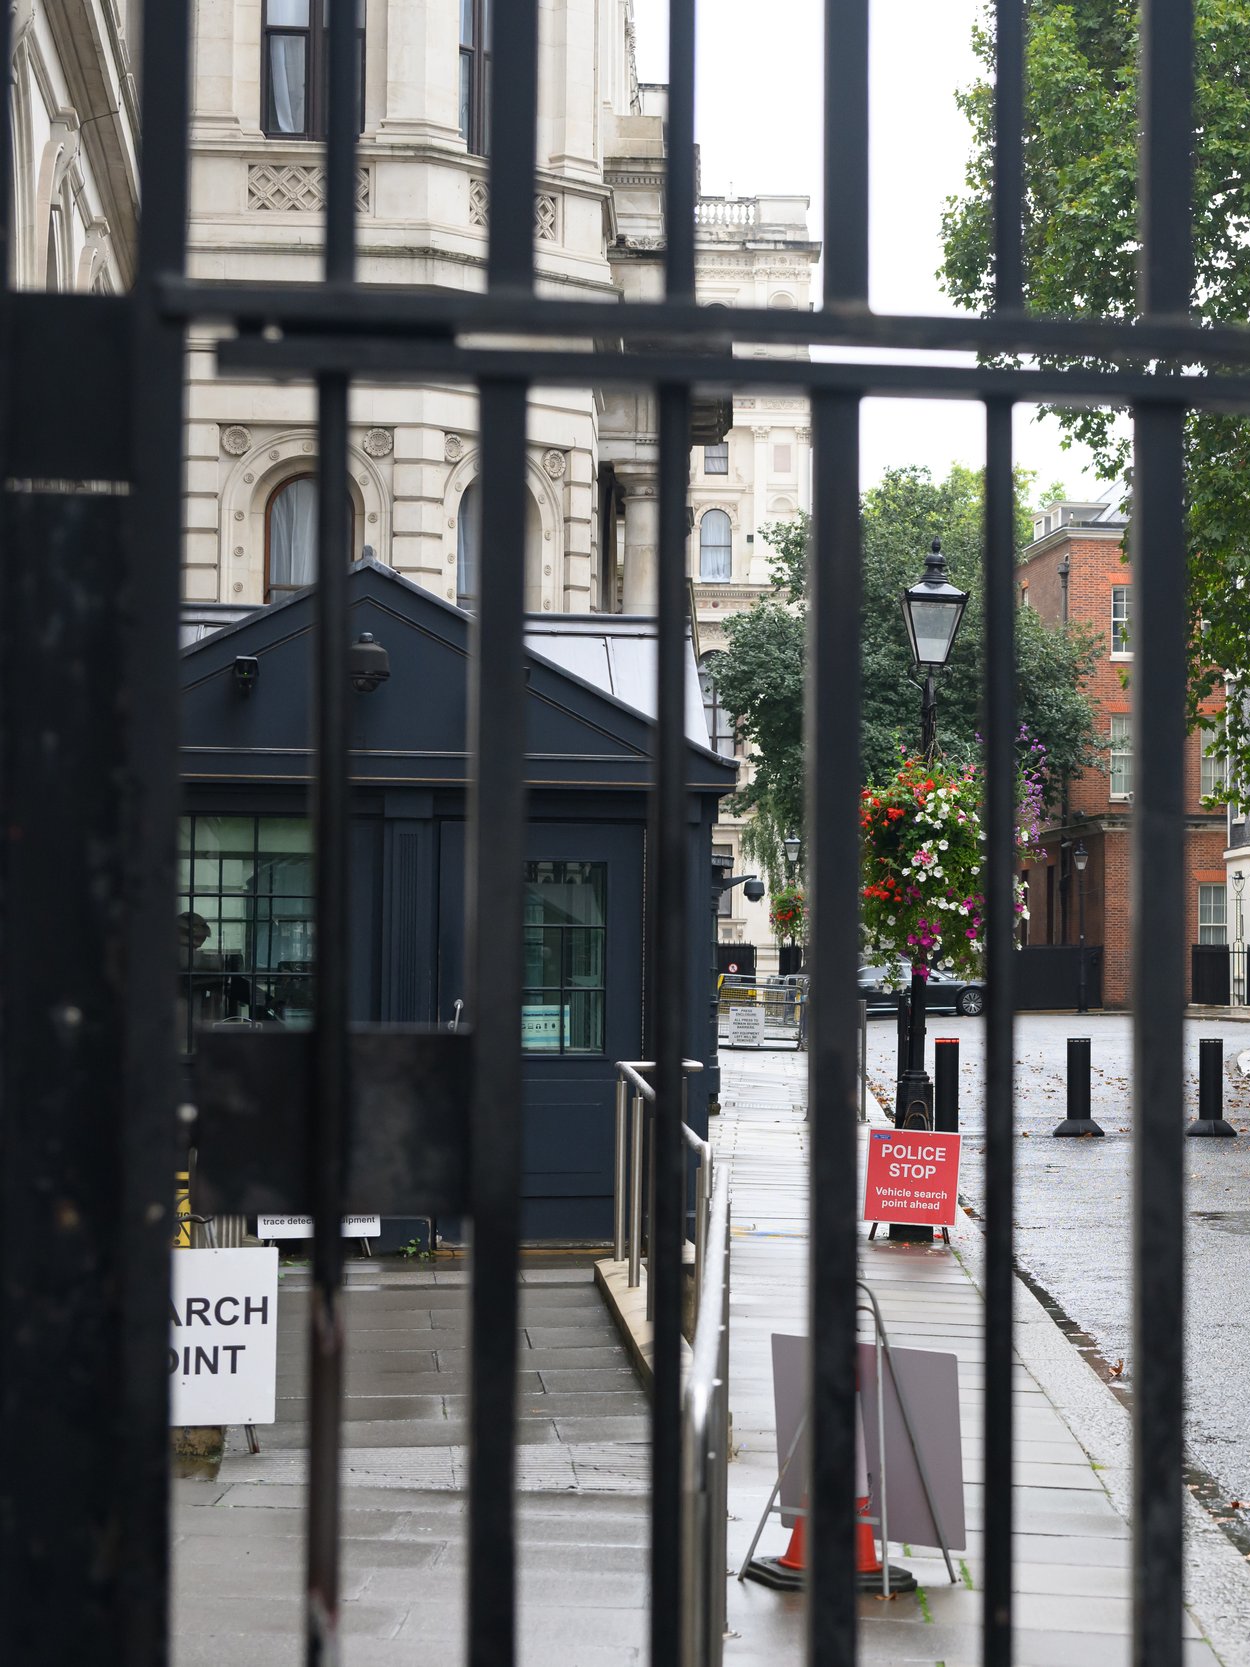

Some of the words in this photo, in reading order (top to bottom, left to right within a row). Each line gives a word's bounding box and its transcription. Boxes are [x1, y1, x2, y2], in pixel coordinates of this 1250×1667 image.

[881, 1144, 946, 1161] POLICE
[889, 1163, 936, 1179] STOP
[875, 1186, 911, 1197] Vehicle
[914, 1190, 948, 1199] search
[881, 1199, 907, 1208] point
[910, 1200, 940, 1210] ahead
